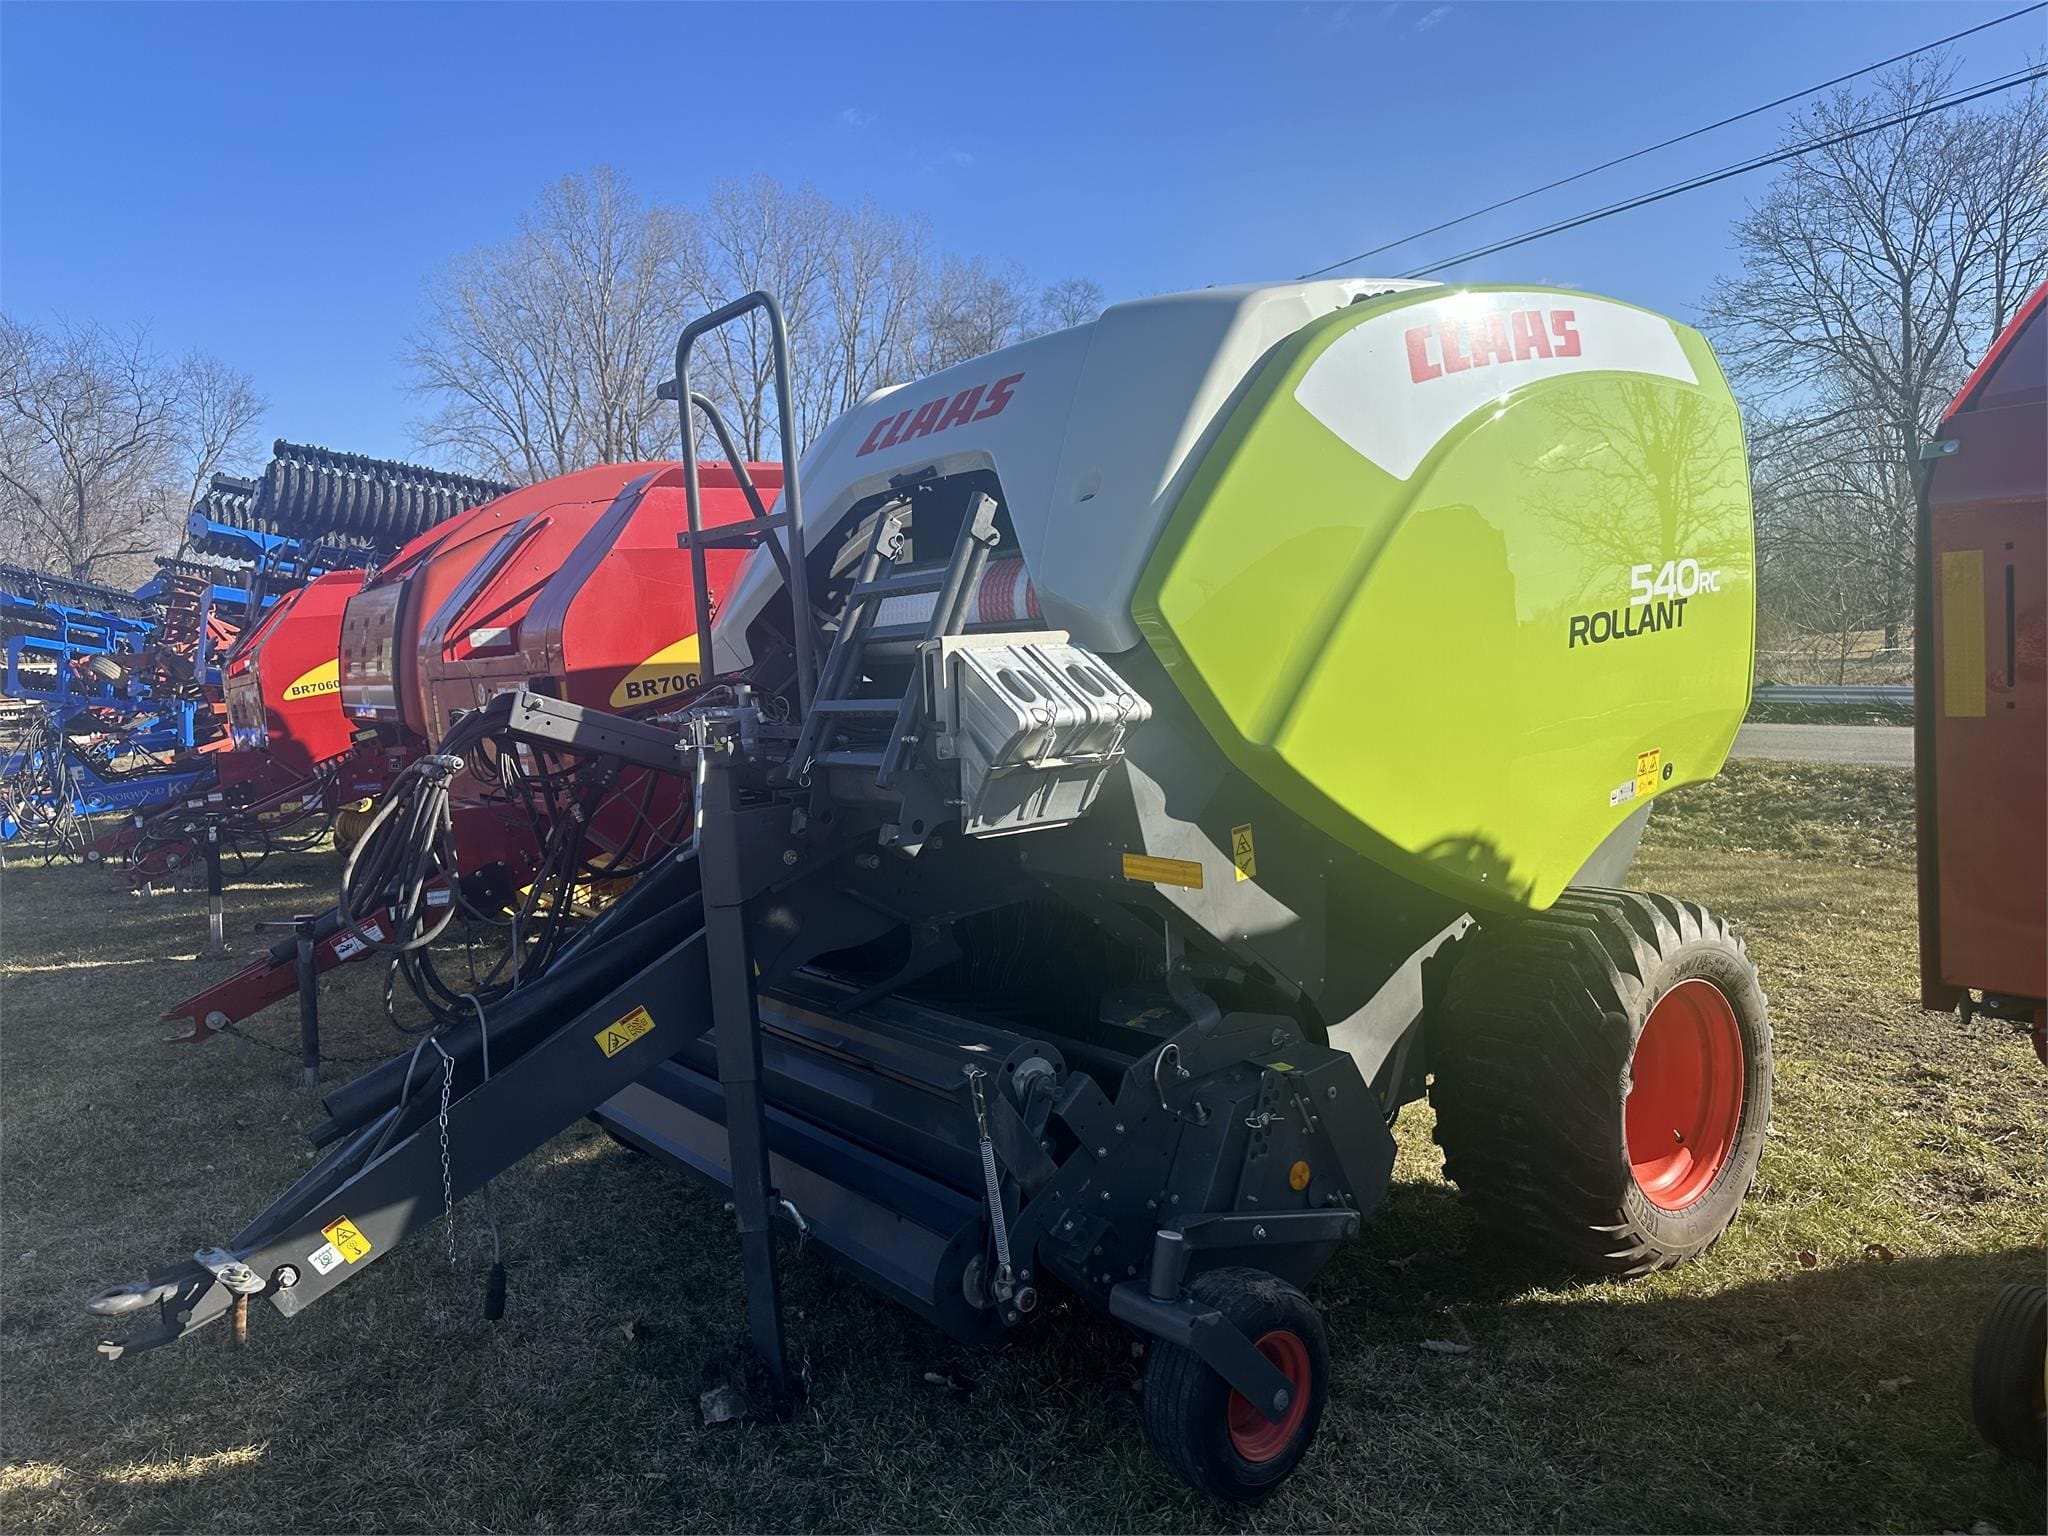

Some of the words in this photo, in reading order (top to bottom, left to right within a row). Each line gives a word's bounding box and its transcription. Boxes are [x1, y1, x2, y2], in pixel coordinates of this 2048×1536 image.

[1404, 309, 1582, 384] CLAAS
[855, 371, 1027, 458] CLAAS
[1568, 597, 1688, 649] ROLLANT
[291, 679, 341, 697] BR7060
[625, 672, 702, 700] BR706
[106, 786, 165, 802] NORWOOD
